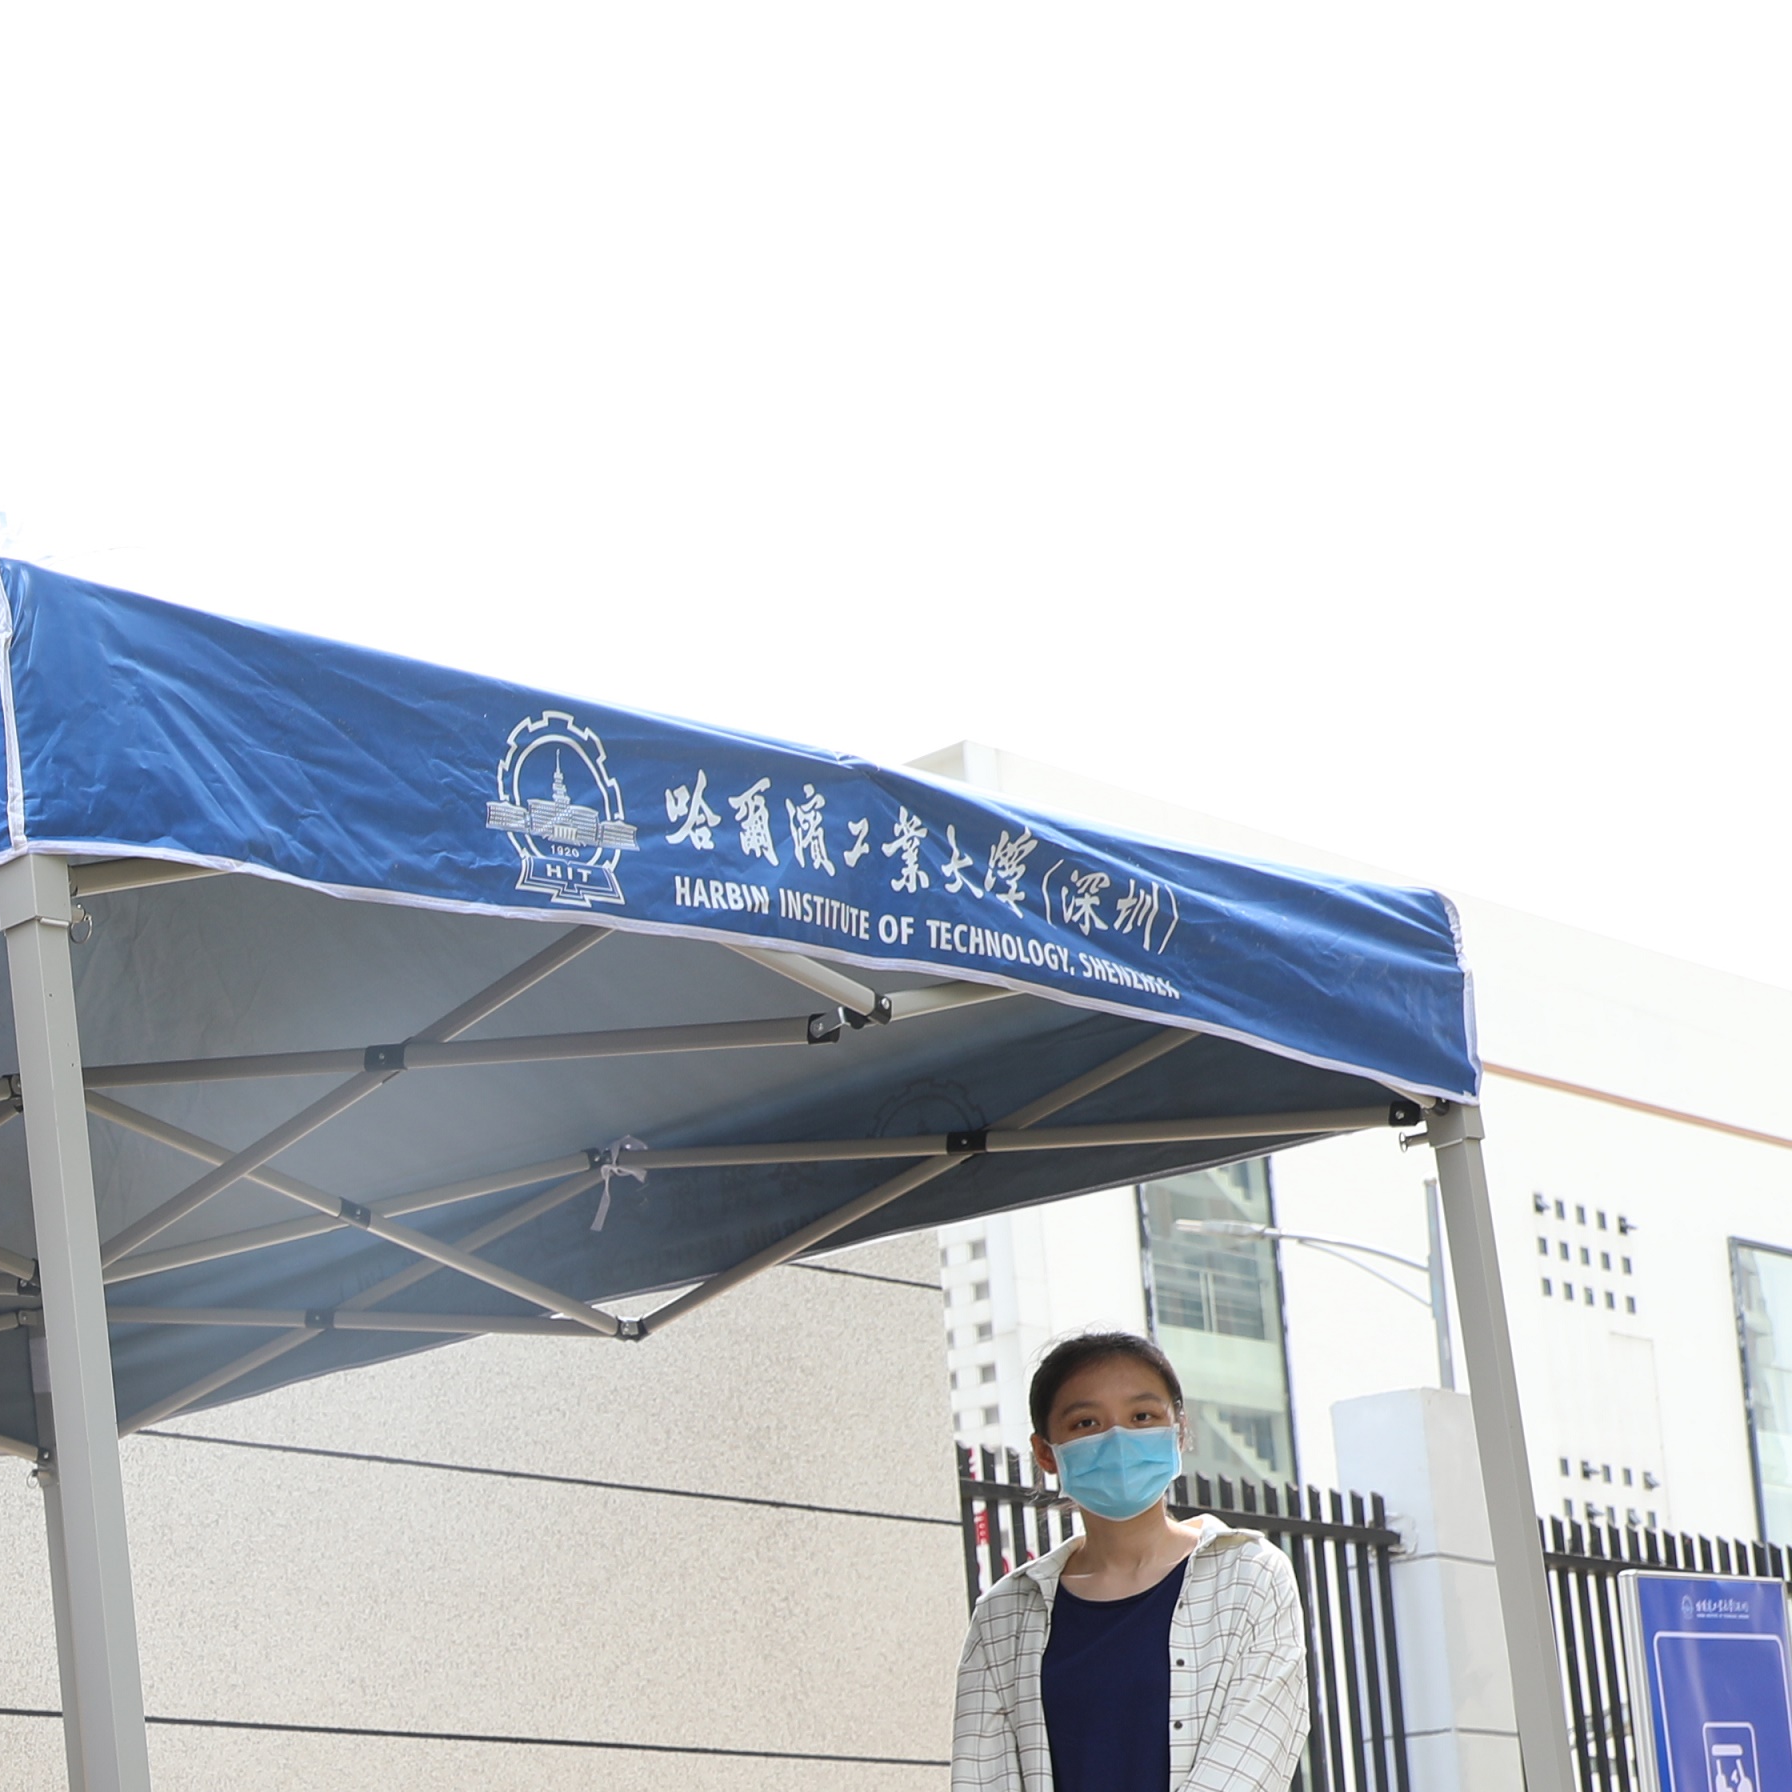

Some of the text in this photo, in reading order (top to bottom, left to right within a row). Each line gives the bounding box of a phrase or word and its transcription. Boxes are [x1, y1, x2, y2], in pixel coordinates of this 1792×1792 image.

[550, 845, 580, 858] 1920
[546, 863, 592, 883] HIT
[675, 875, 1181, 1000] HARBIN INSTITUTE OF TECHNOLOGY, SHENZHEN
